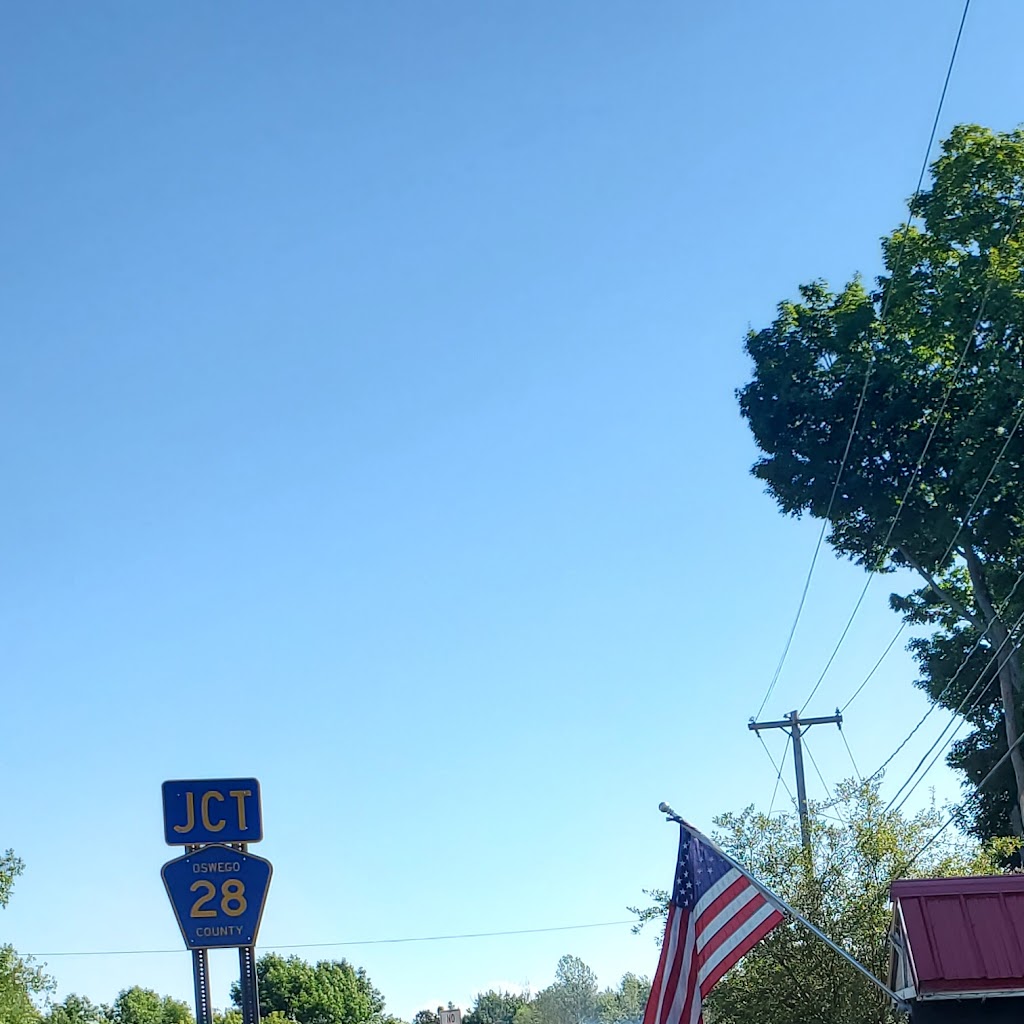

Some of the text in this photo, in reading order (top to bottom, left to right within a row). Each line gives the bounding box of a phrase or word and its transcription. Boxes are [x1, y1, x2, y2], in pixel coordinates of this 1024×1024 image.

[173, 790, 252, 834] JCT
[192, 862, 241, 873] OSWEGO
[190, 879, 248, 918] 28
[196, 926, 244, 937] COUNTY
[446, 1013, 456, 1023] NO
